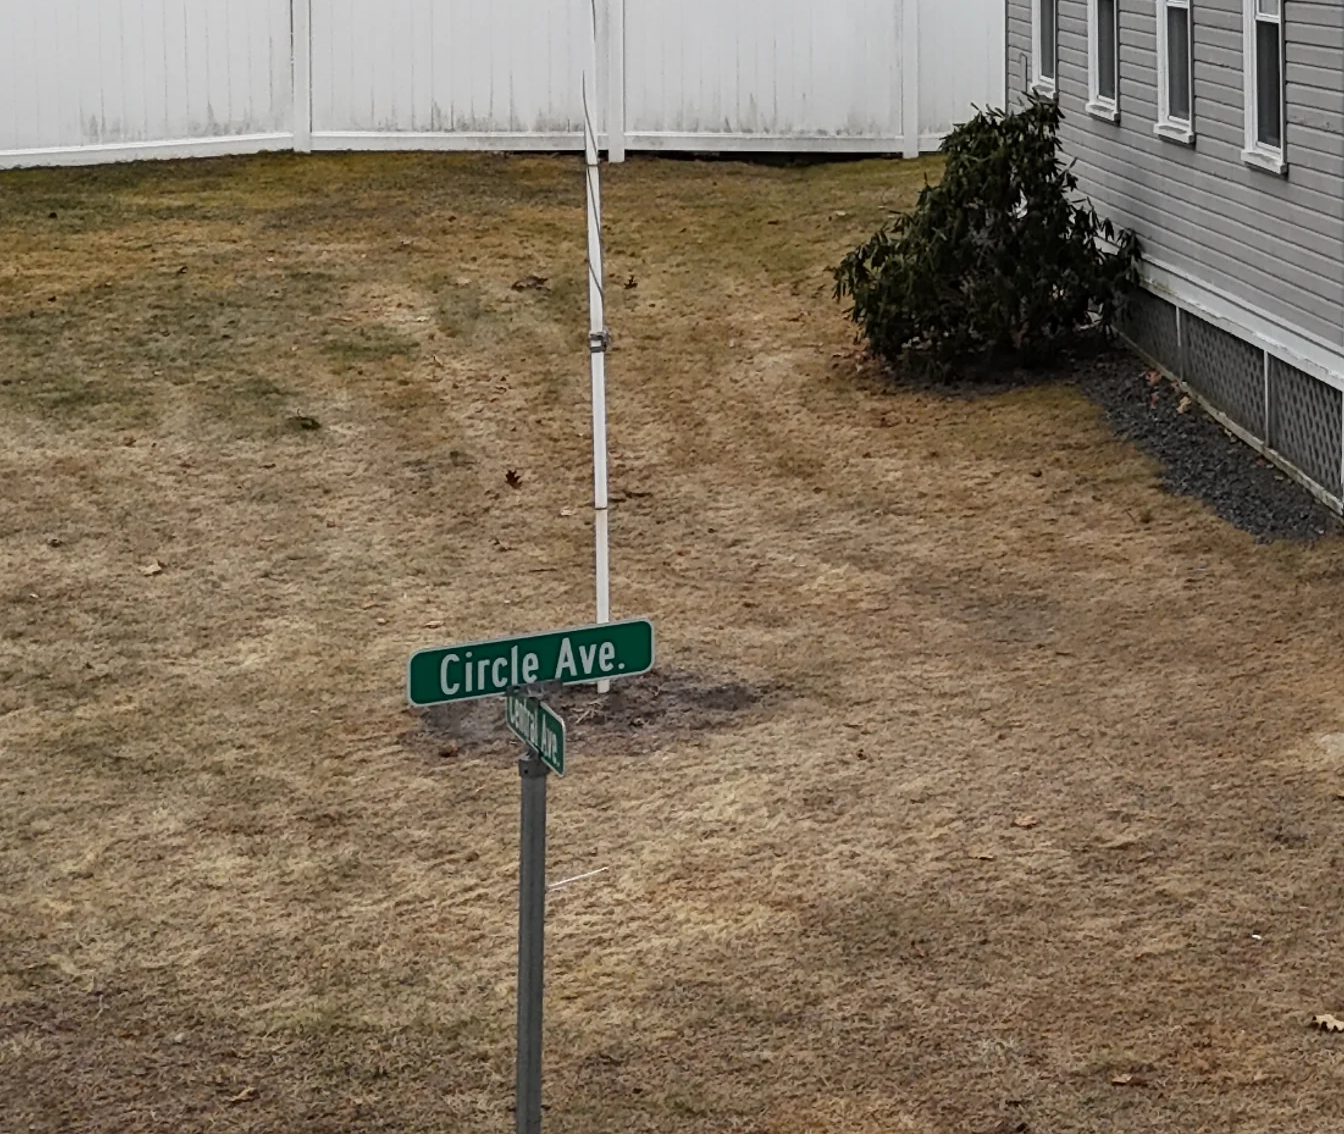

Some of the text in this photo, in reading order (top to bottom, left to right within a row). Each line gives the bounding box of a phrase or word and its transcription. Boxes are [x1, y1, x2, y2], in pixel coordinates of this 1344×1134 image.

[440, 637, 625, 695] Circle Ave.
[540, 714, 561, 767] Ave.
